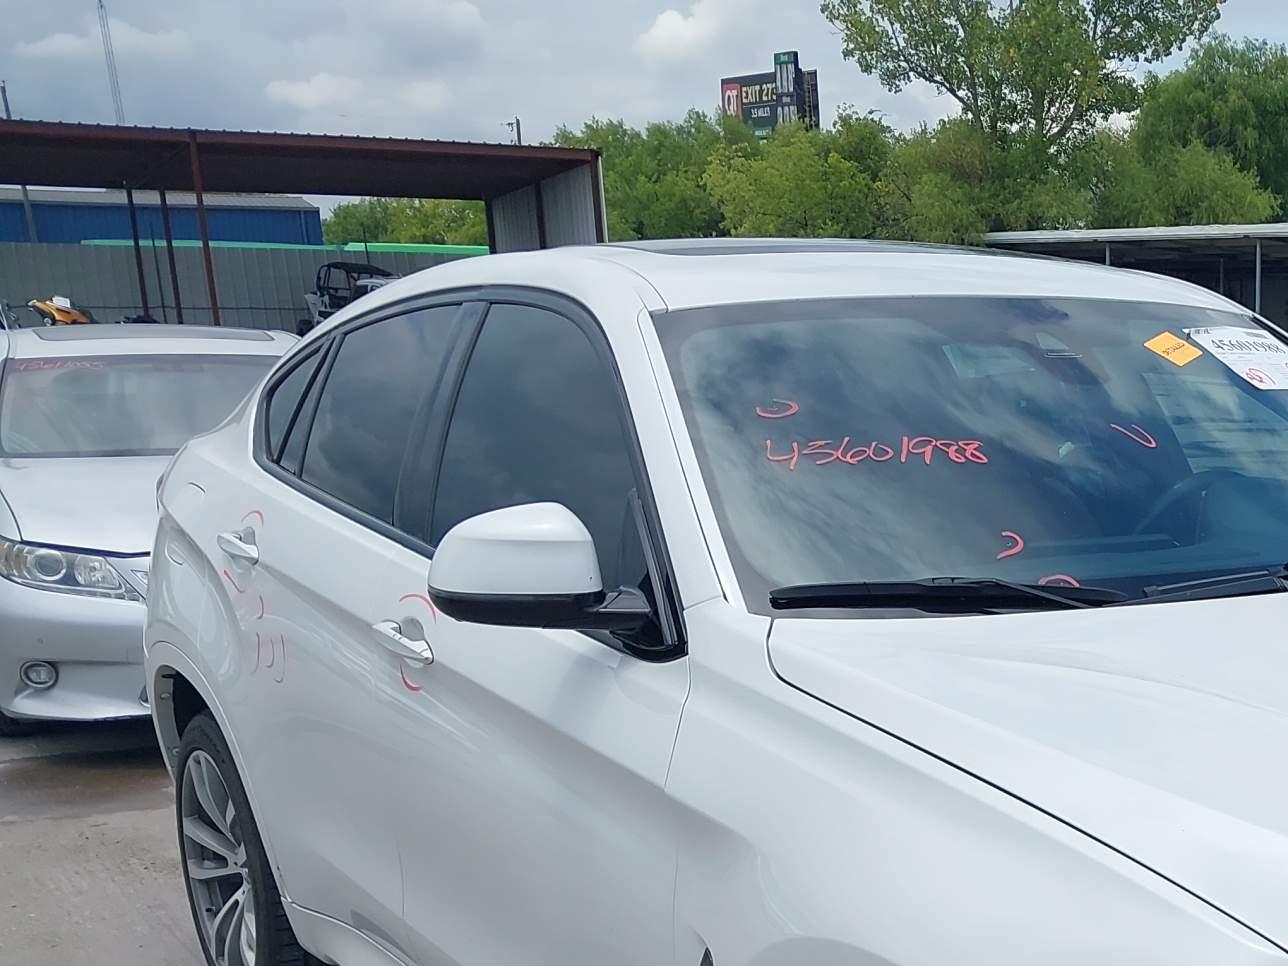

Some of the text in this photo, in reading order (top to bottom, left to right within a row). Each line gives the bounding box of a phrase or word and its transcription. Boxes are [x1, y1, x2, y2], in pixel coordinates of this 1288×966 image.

[725, 89, 738, 116] QT
[742, 85, 760, 103] EXIT
[766, 436, 988, 470] 45601988
